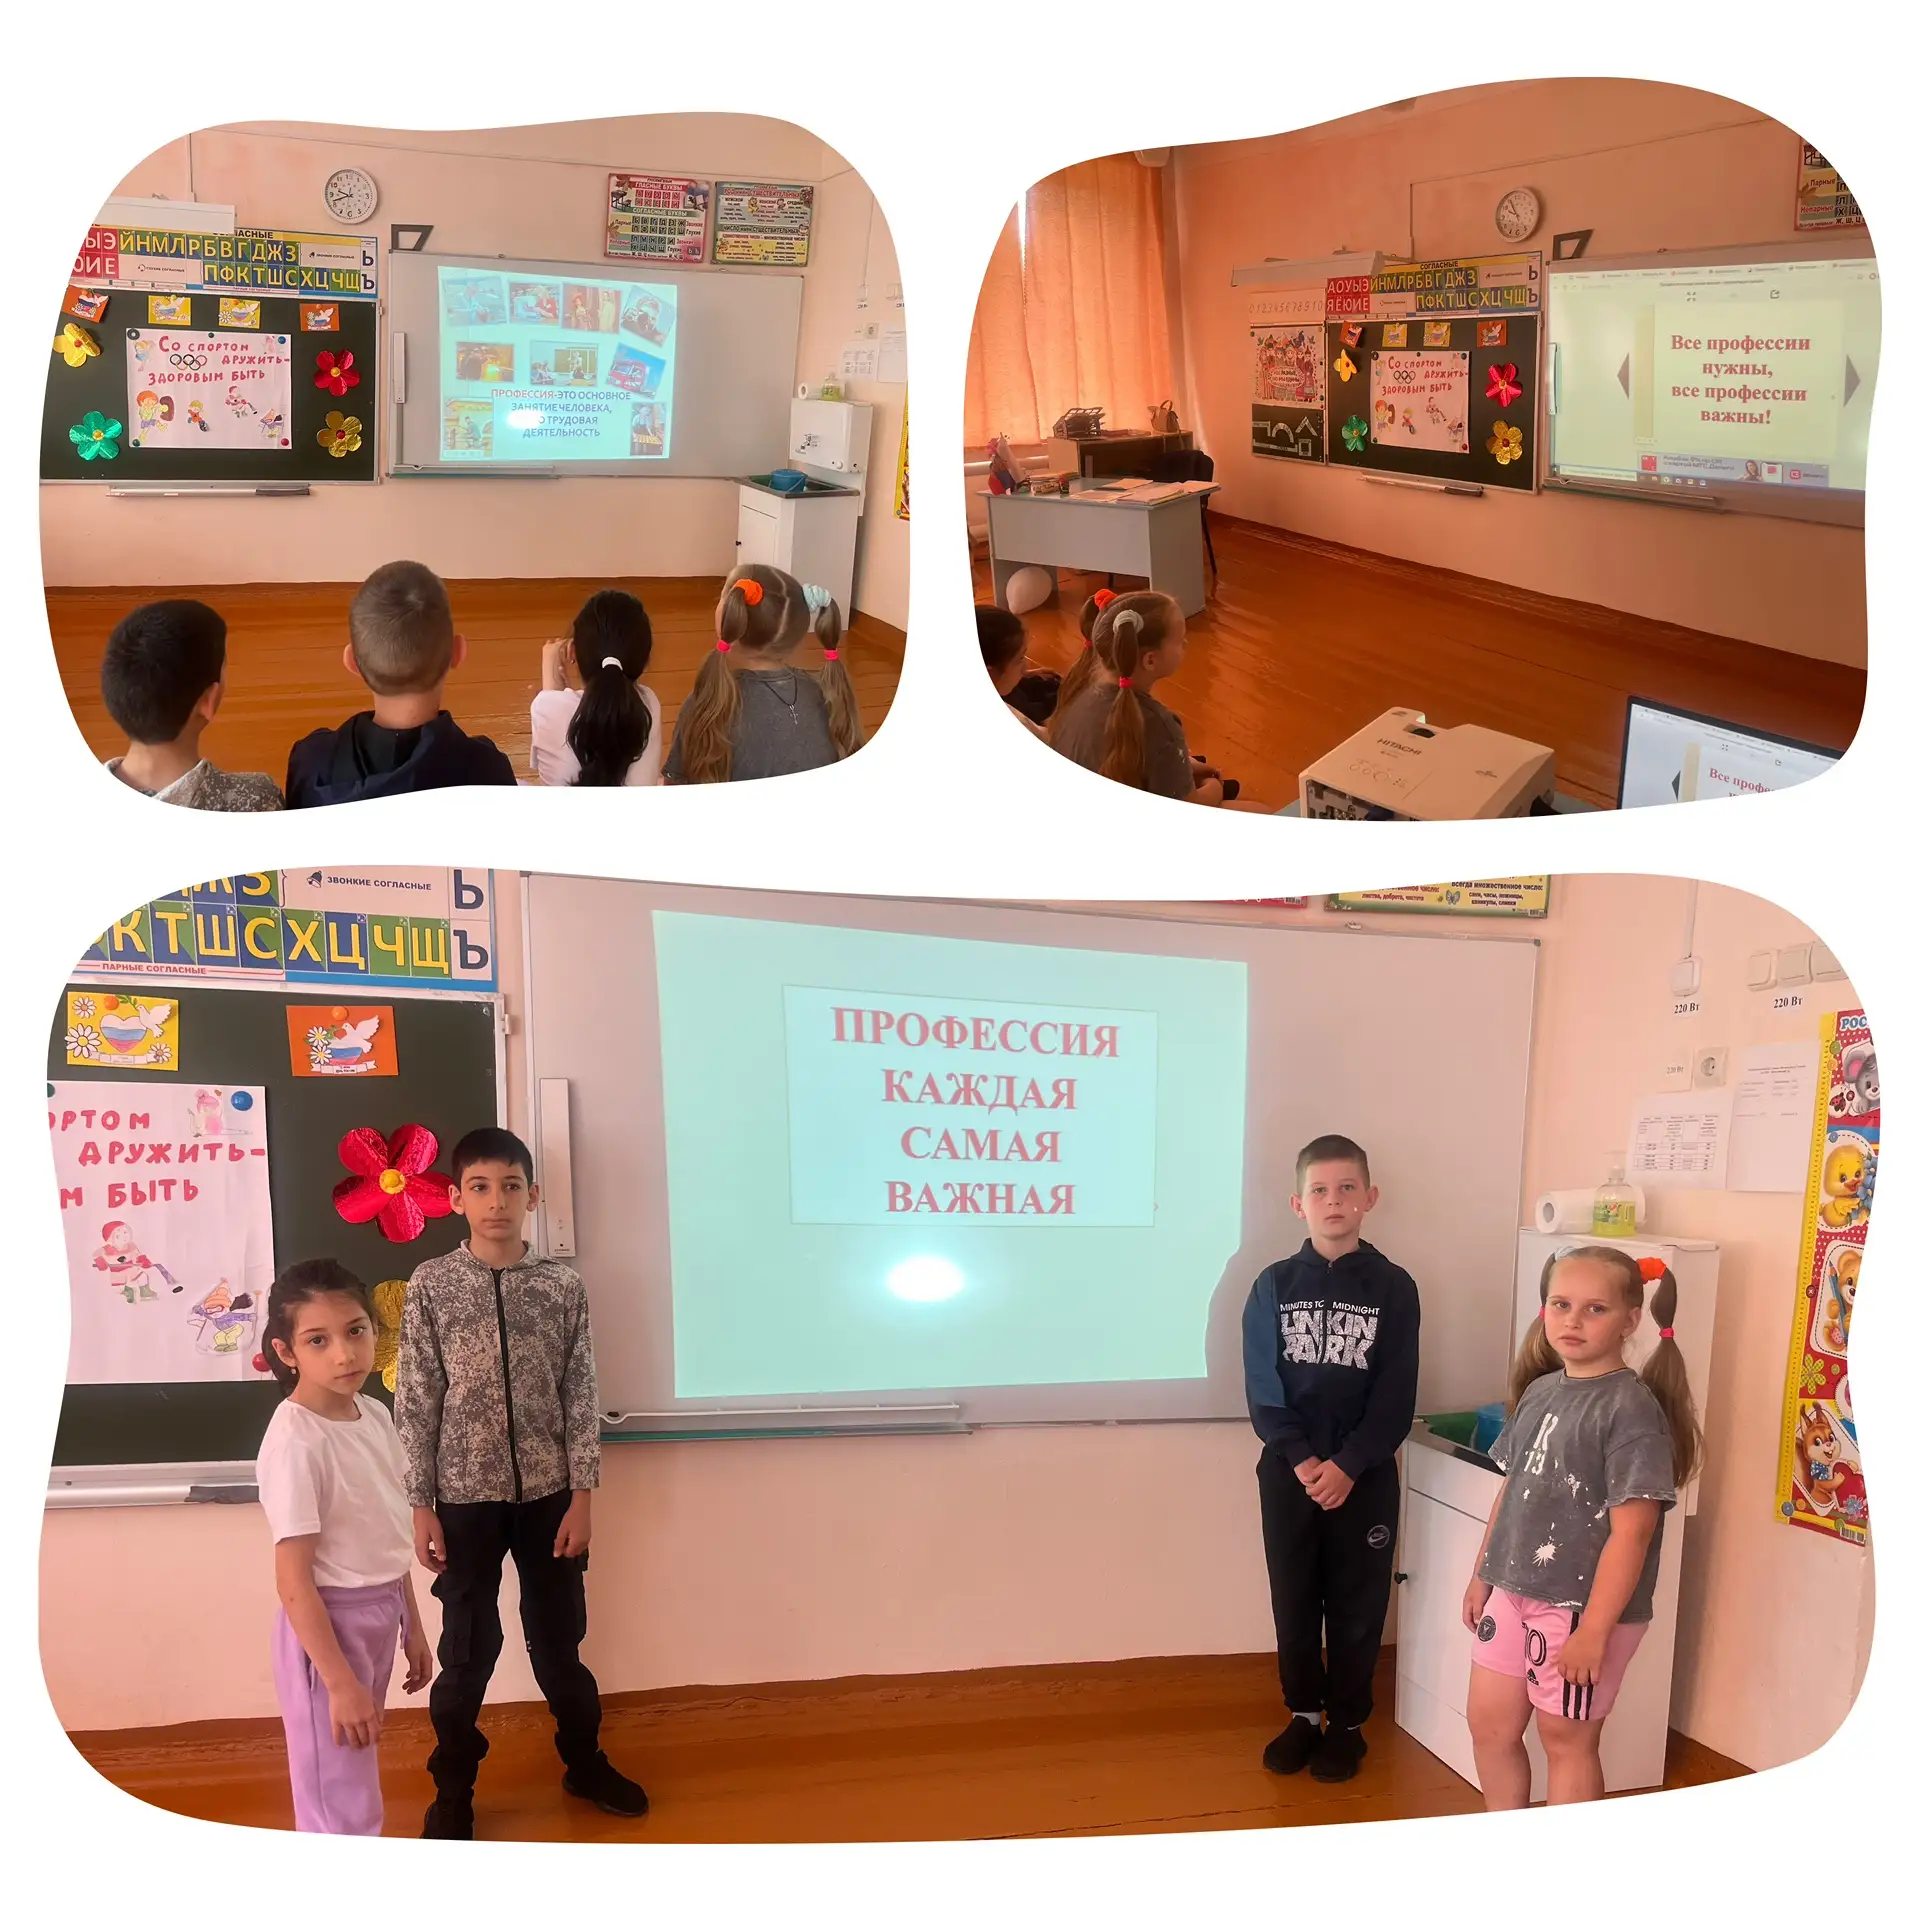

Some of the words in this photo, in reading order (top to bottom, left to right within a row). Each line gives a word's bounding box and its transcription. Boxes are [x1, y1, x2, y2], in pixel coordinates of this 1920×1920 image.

[213, 230, 274, 239] АСНЫЕ
[1420, 261, 1459, 270] СОГЛАСНЫЕ
[1671, 335, 1701, 350] Все
[1707, 335, 1810, 354] профессии
[148, 372, 224, 386] ЗДОРОВЫМ
[232, 370, 265, 382] БЫТЬ
[1702, 363, 1773, 378] нужны,
[578, 392, 631, 400] ОСНОВНОЕ
[1382, 385, 1425, 396] ЗДОРОВЫМ
[1430, 383, 1452, 392] БЫТЬ
[1672, 386, 1700, 397] все
[1705, 385, 1807, 403] профессии
[548, 416, 598, 426] ТРУДОВАЯ
[1700, 409, 1771, 424] важны!
[523, 428, 600, 438] ДЕЯТЕЛЬНОСТЬ
[1377, 738, 1422, 755] HITACHI
[1710, 768, 1730, 782] Все
[1733, 777, 1774, 793] профе
[327, 876, 371, 887] ЗВОНКИЕ
[374, 880, 432, 890] СОГЛАСНЫЕ
[102, 963, 144, 972] ПАРНЫЕ
[146, 965, 206, 975] СОГЛАСНЫЕ
[1674, 1004, 1688, 1014] 220
[1690, 1003, 1700, 1012] Вт
[1774, 998, 1788, 1008] 220
[1792, 996, 1803, 1007] Вт
[830, 1006, 1120, 1058] ПРОФЕССИЯ
[880, 1069, 1078, 1116] КАЖДАЯ
[901, 1126, 1062, 1162] САМАЯ
[108, 1179, 198, 1208] БЫТЬ
[884, 1180, 1076, 1215] ВАЖНАЯ
[1280, 1301, 1312, 1311] MINUTES
[1332, 1302, 1380, 1315] MIDNIGHT
[1282, 1334, 1374, 1370] PARK
